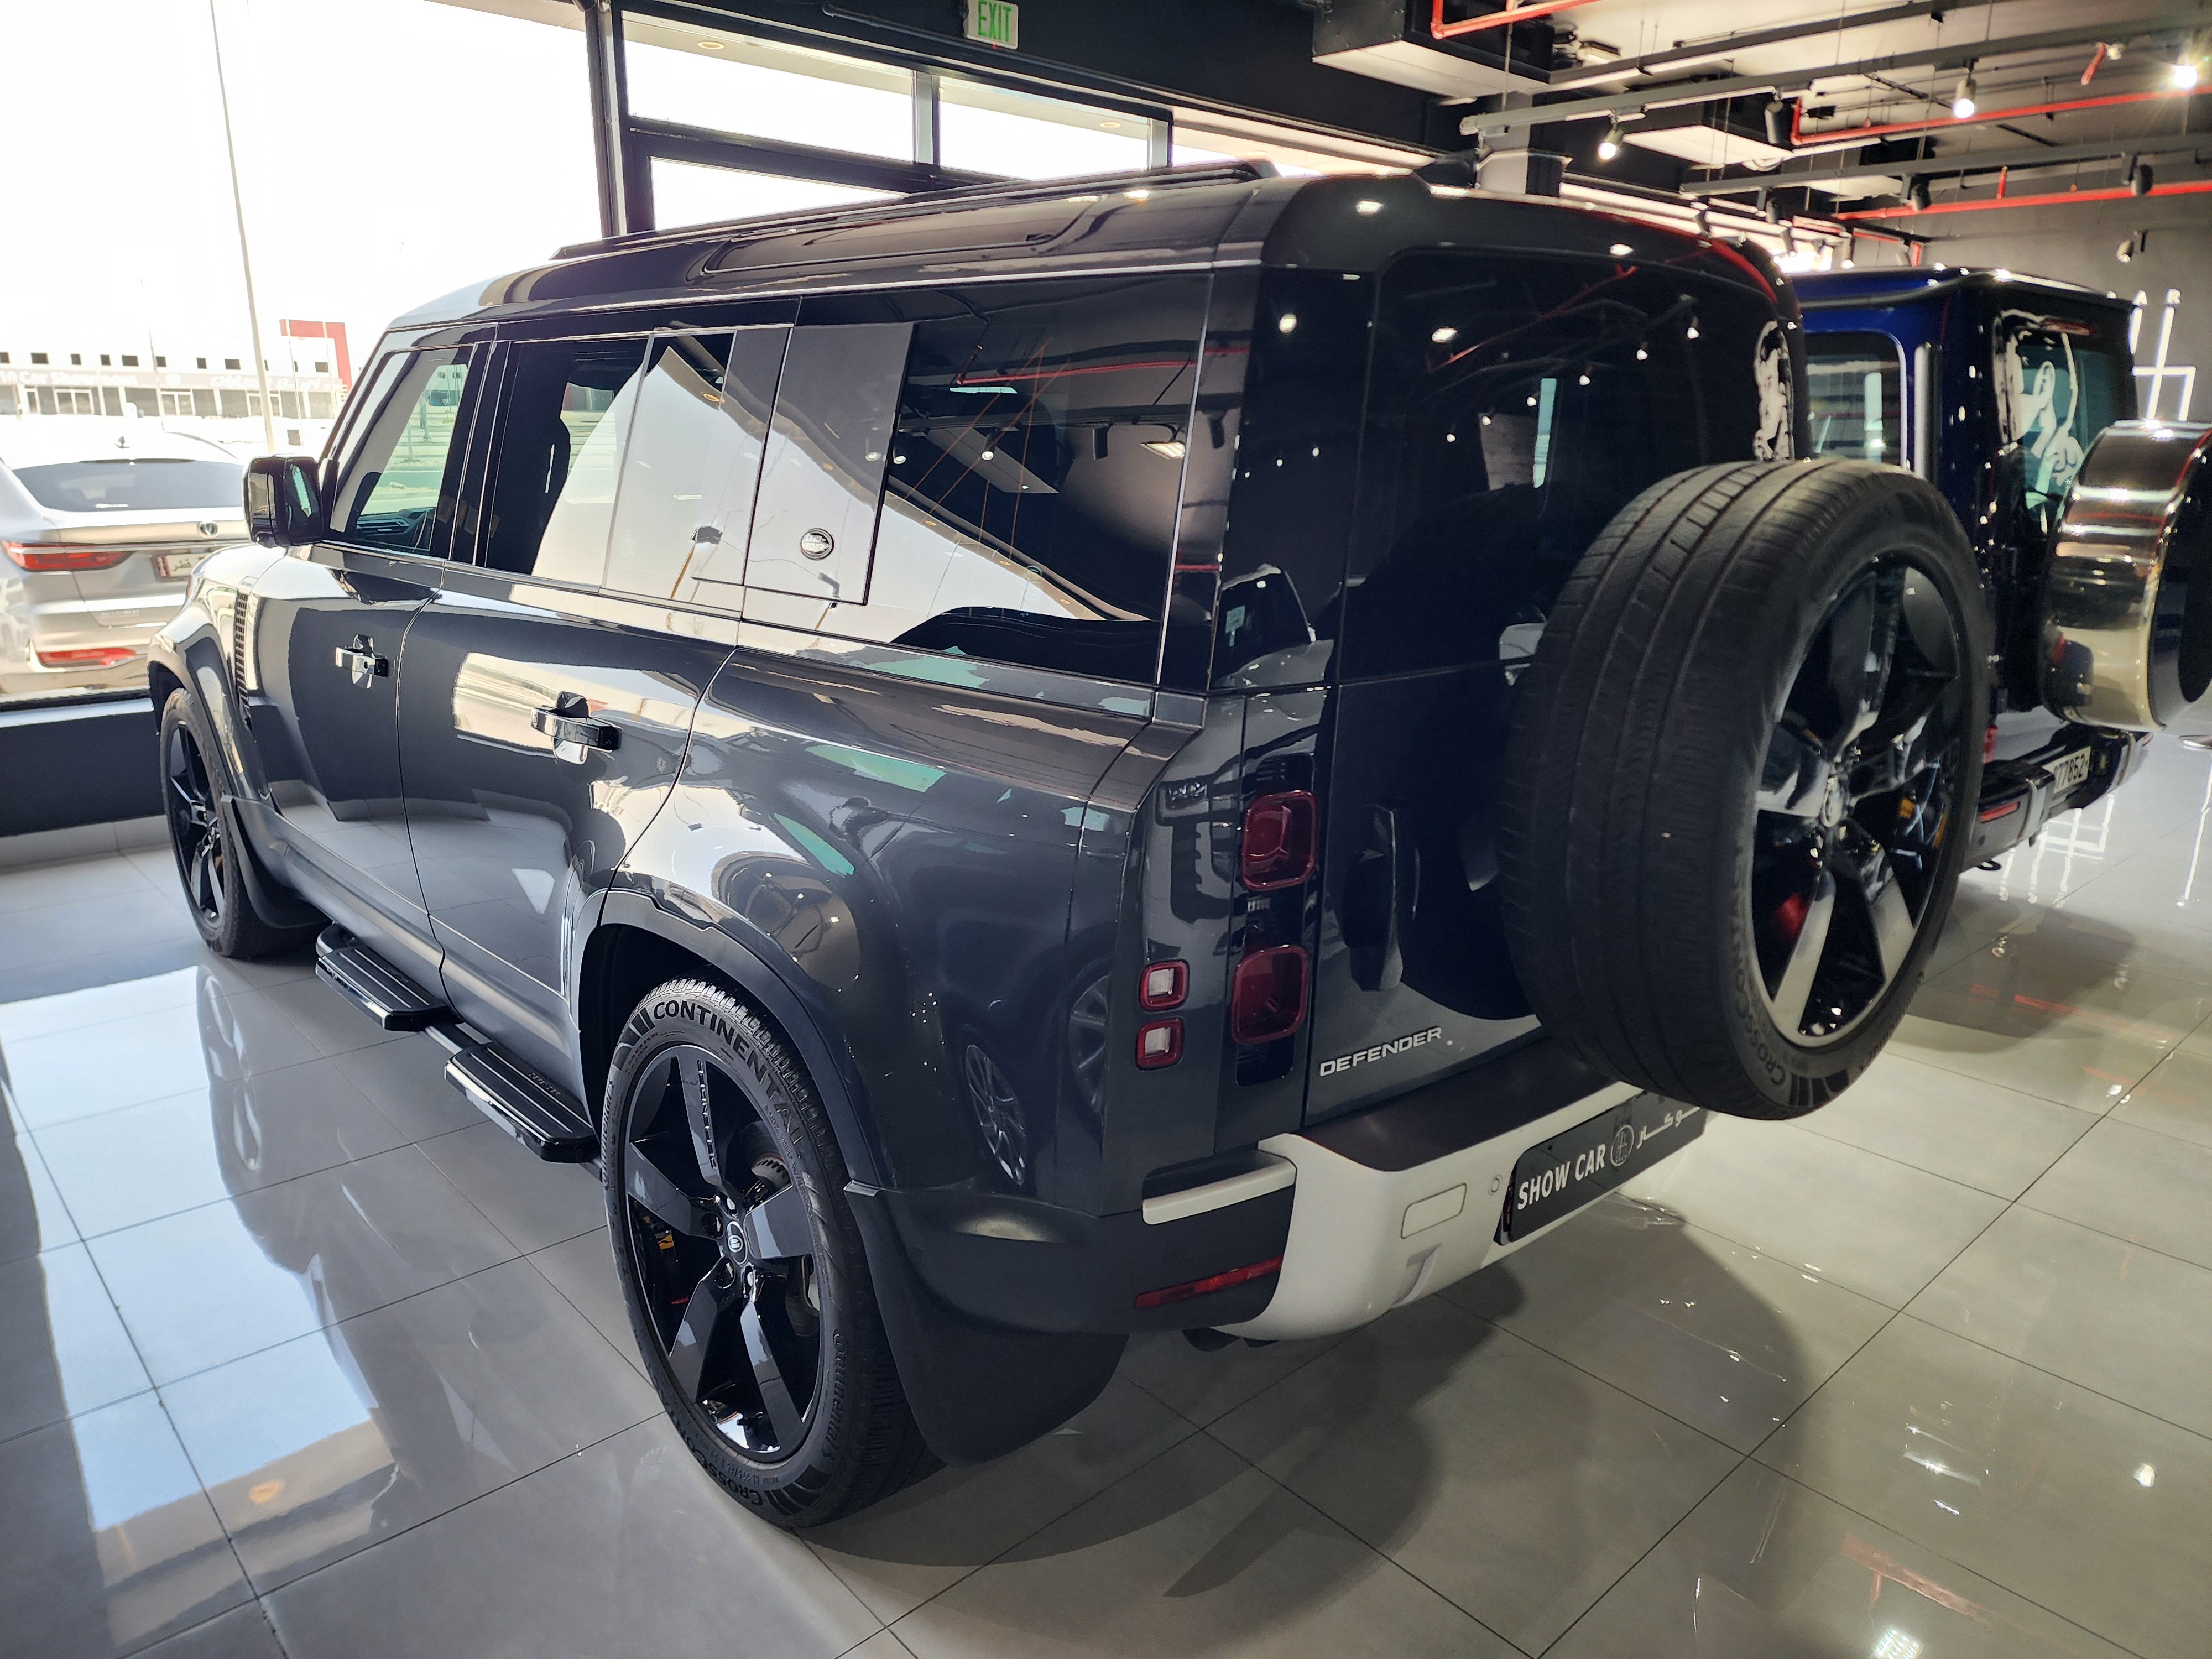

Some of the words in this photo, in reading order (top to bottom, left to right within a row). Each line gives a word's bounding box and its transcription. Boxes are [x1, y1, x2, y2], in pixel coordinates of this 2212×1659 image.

[978, 0, 1011, 43] EXIT
[19, 370, 48, 384] Car
[173, 559, 192, 572] قطر
[1319, 1026, 1442, 1078] DEFENDER
[653, 1001, 805, 1159] CONTINENTAL
[1517, 1160, 1569, 1211] SHOW
[1574, 1143, 1607, 1183] CAR
